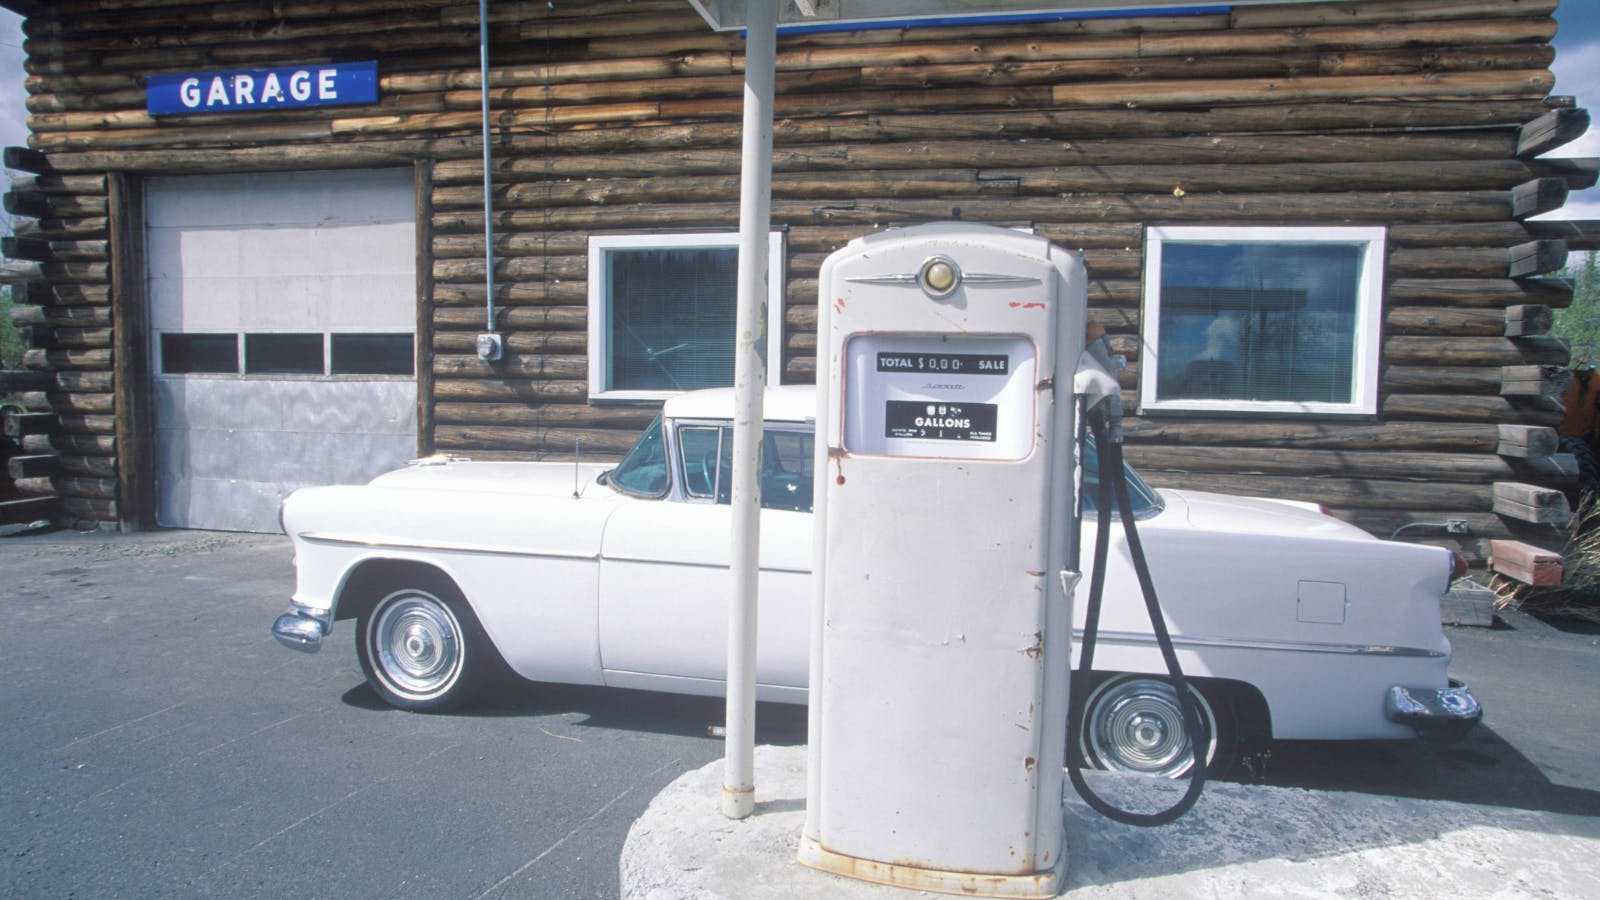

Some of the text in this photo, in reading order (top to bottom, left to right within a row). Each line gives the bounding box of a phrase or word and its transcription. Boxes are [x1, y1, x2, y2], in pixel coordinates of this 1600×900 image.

[180, 69, 337, 108] GARAGE
[880, 358, 913, 368] TOTAL
[978, 360, 1005, 370] SALE
[914, 417, 971, 429] GALLONS
